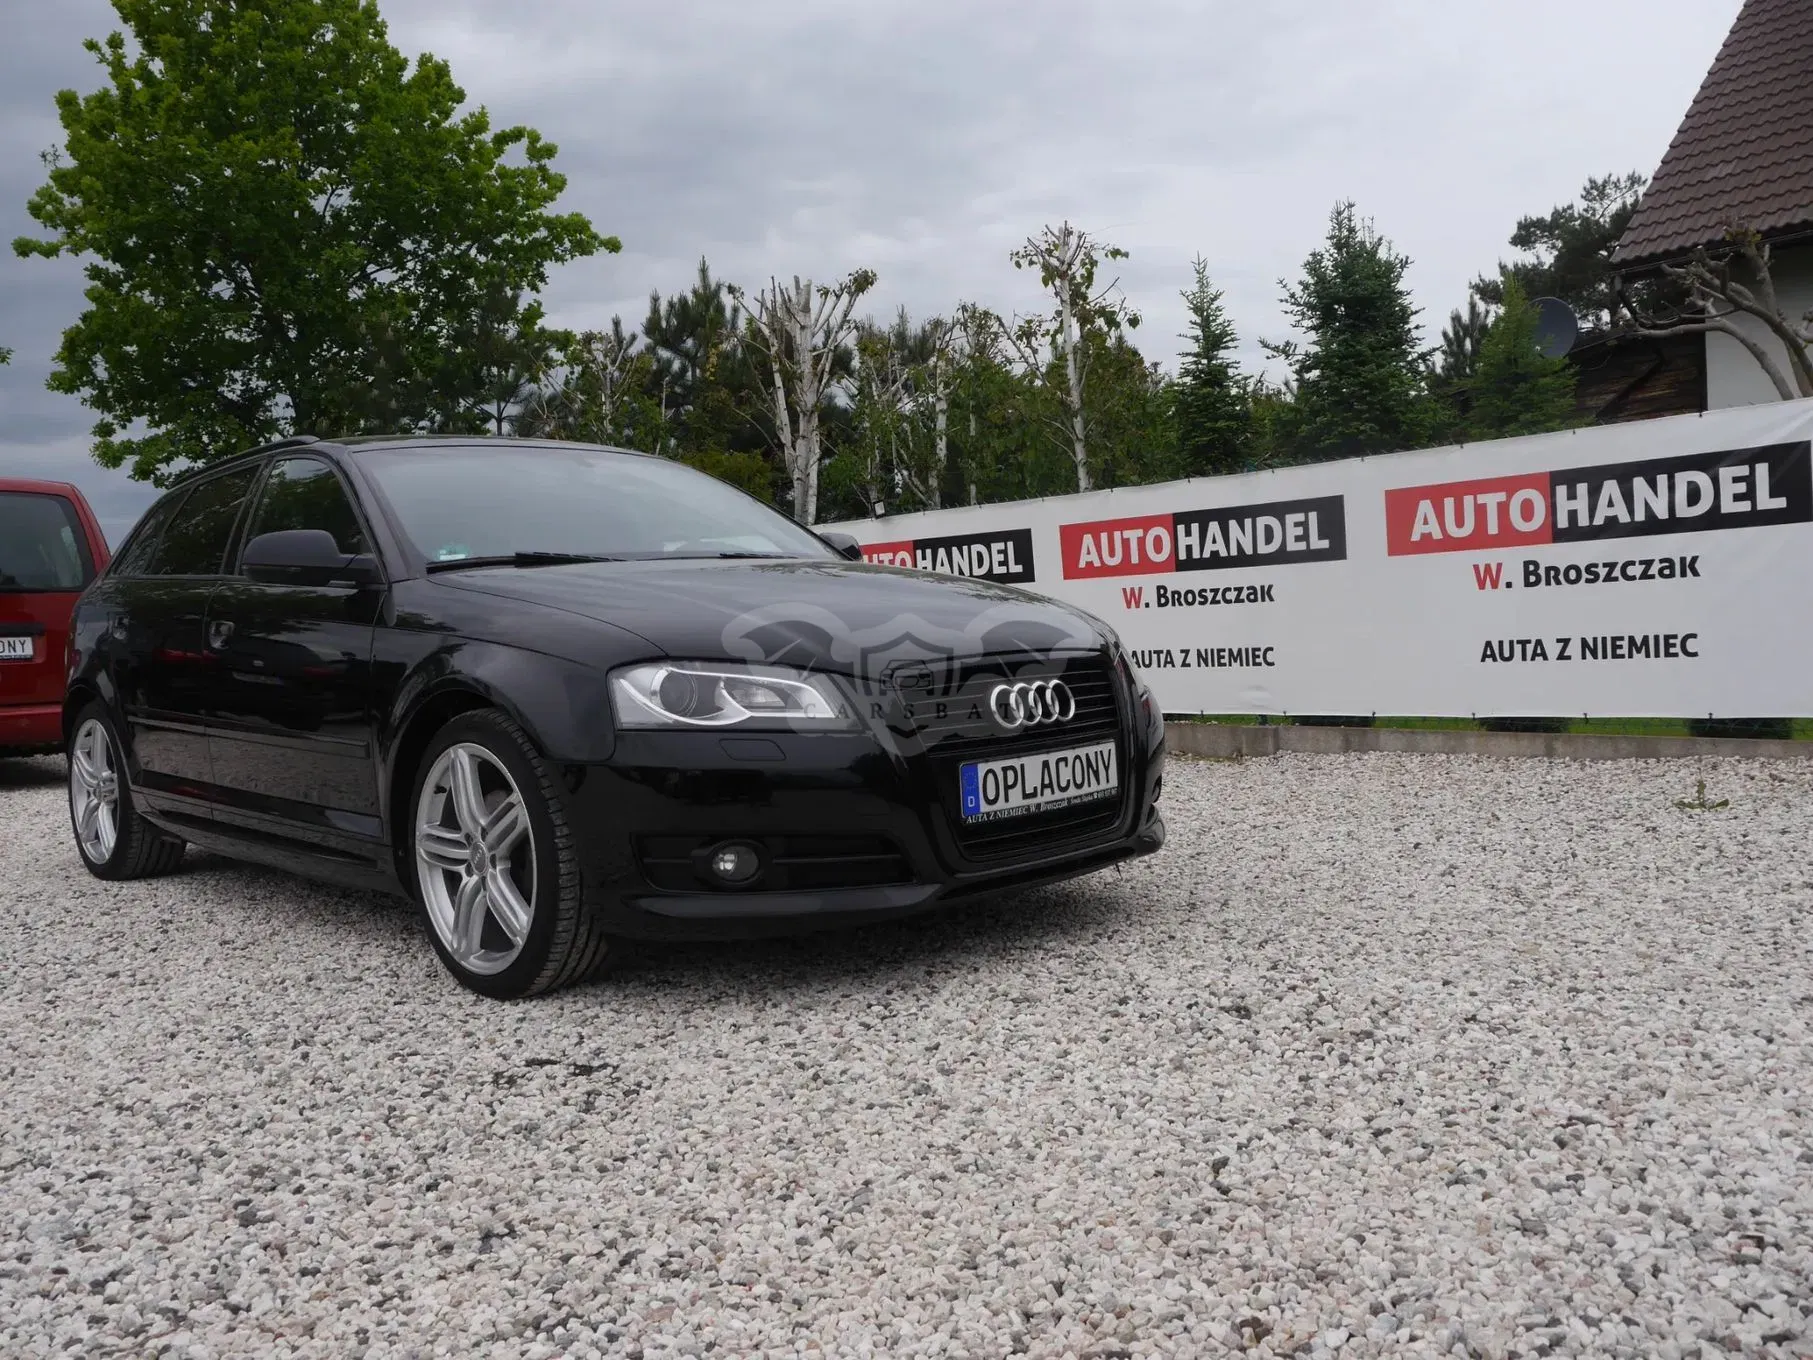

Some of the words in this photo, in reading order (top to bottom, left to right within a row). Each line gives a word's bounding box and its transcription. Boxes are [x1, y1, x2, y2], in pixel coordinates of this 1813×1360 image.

[1473, 563, 1513, 590] W.
[1122, 587, 1150, 609] W.
[1180, 649, 1191, 668] Z
[1197, 647, 1275, 668] NIEMIEC
[1480, 639, 1548, 662] AUTA
[1555, 637, 1572, 661] Z
[1581, 633, 1699, 660] NIEMIEC
[982, 748, 1112, 806] OPLACONY
[968, 796, 976, 808] D
[966, 811, 988, 824] AUTA
[988, 812, 997, 821] Z
[996, 805, 1028, 821] NIEMIEC
